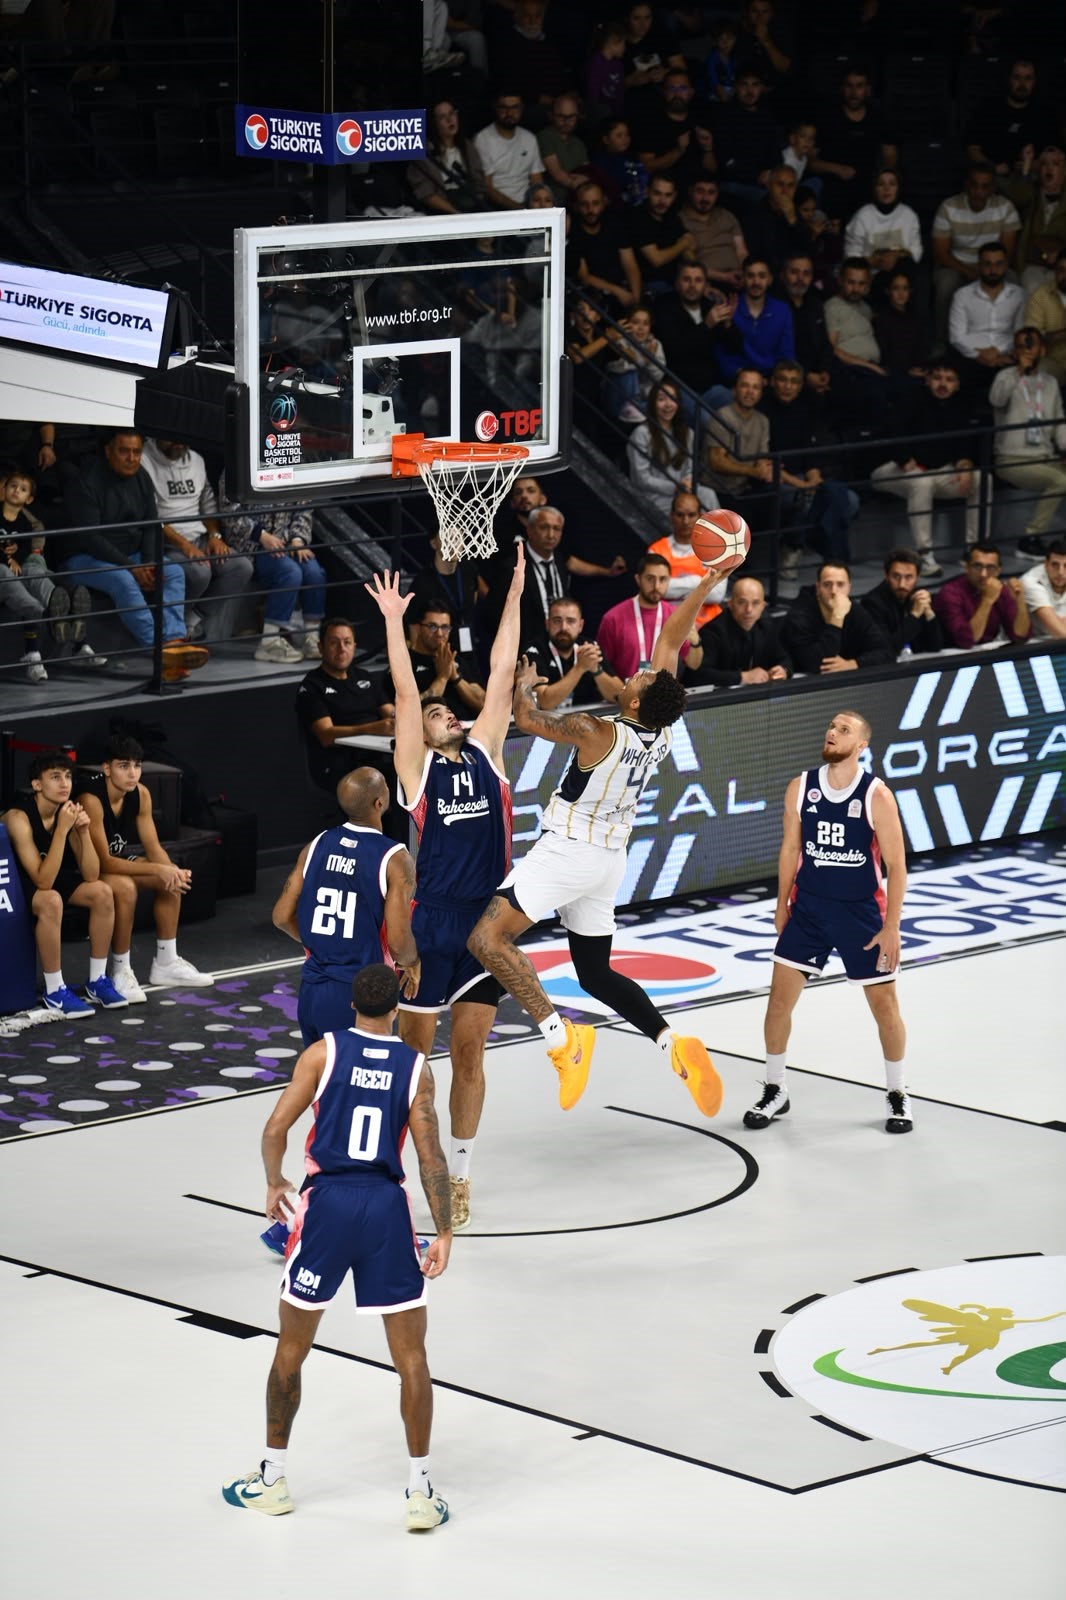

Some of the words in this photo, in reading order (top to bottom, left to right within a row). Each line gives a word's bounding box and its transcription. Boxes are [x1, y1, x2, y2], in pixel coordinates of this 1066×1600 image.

[42, 315, 71, 333] Gücü,
[365, 306, 452, 328] www.tbf.org.tr
[500, 408, 542, 437] TBF
[264, 448, 302, 457] BASKETBOL
[265, 457, 287, 465] SÜPER
[857, 724, 1066, 780] OREA
[451, 770, 475, 797] 14
[626, 765, 648, 800] 4
[816, 820, 846, 848] 22
[805, 840, 867, 863] Bahçeşehir
[311, 887, 357, 938] 24
[350, 1066, 393, 1091] REED
[347, 1105, 383, 1162] 0
[296, 1266, 322, 1290] HDI
